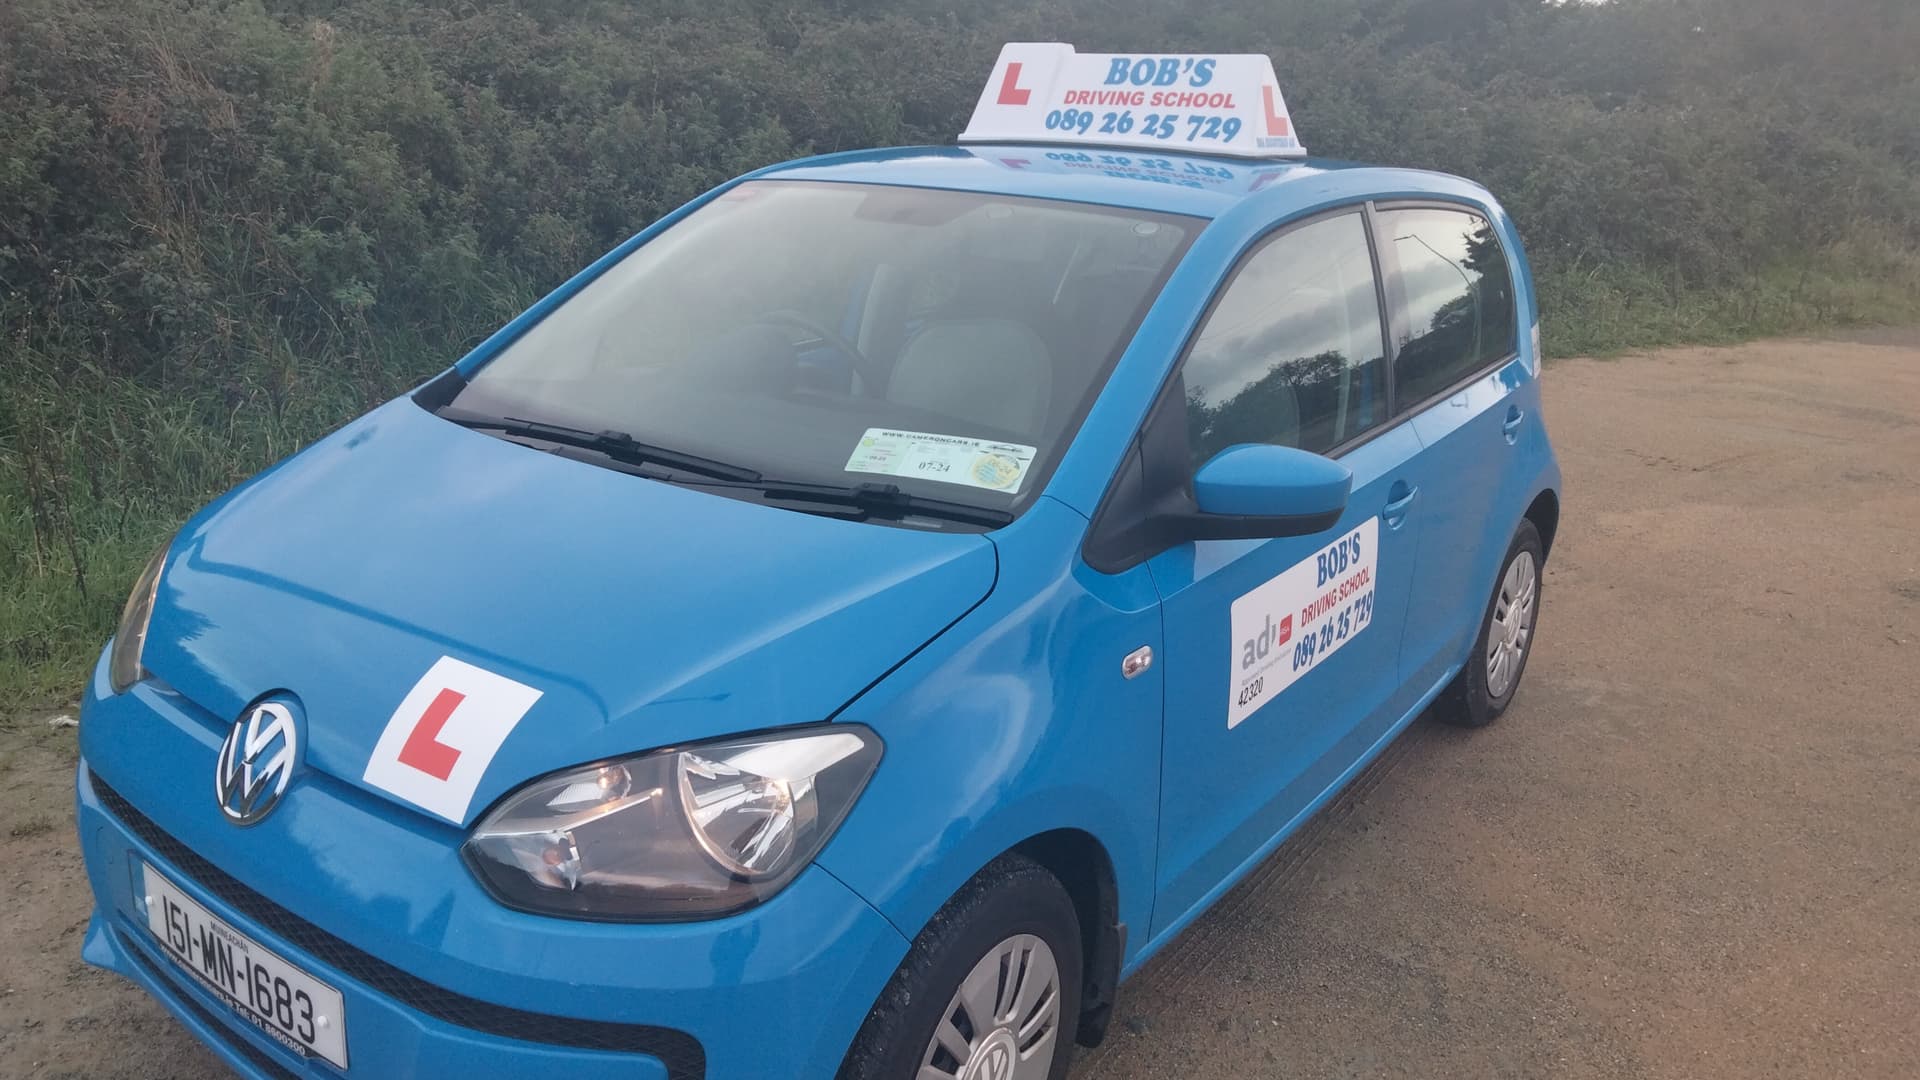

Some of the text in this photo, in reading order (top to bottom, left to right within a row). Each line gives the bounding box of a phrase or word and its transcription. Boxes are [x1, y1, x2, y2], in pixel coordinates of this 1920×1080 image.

[997, 62, 1031, 105] L
[1103, 57, 1216, 87] BOB'S
[1063, 90, 1236, 109] DRIVING SCHOOL
[1262, 85, 1289, 136] L
[1045, 108, 1094, 135] 089
[1098, 110, 1134, 134] 26
[1140, 113, 1179, 139] 25
[1186, 115, 1242, 143] 729
[918, 461, 952, 472] 07-24
[1316, 532, 1360, 588] BOB'S
[1301, 566, 1370, 627] DRIVING SCHOOL
[1292, 632, 1316, 672] 089
[1318, 617, 1334, 655] 26
[1336, 609, 1351, 641] 25
[1353, 590, 1373, 632] 729
[1238, 676, 1264, 707] 42320
[397, 687, 466, 781] L
[162, 895, 316, 1045] 151-MN-1683
